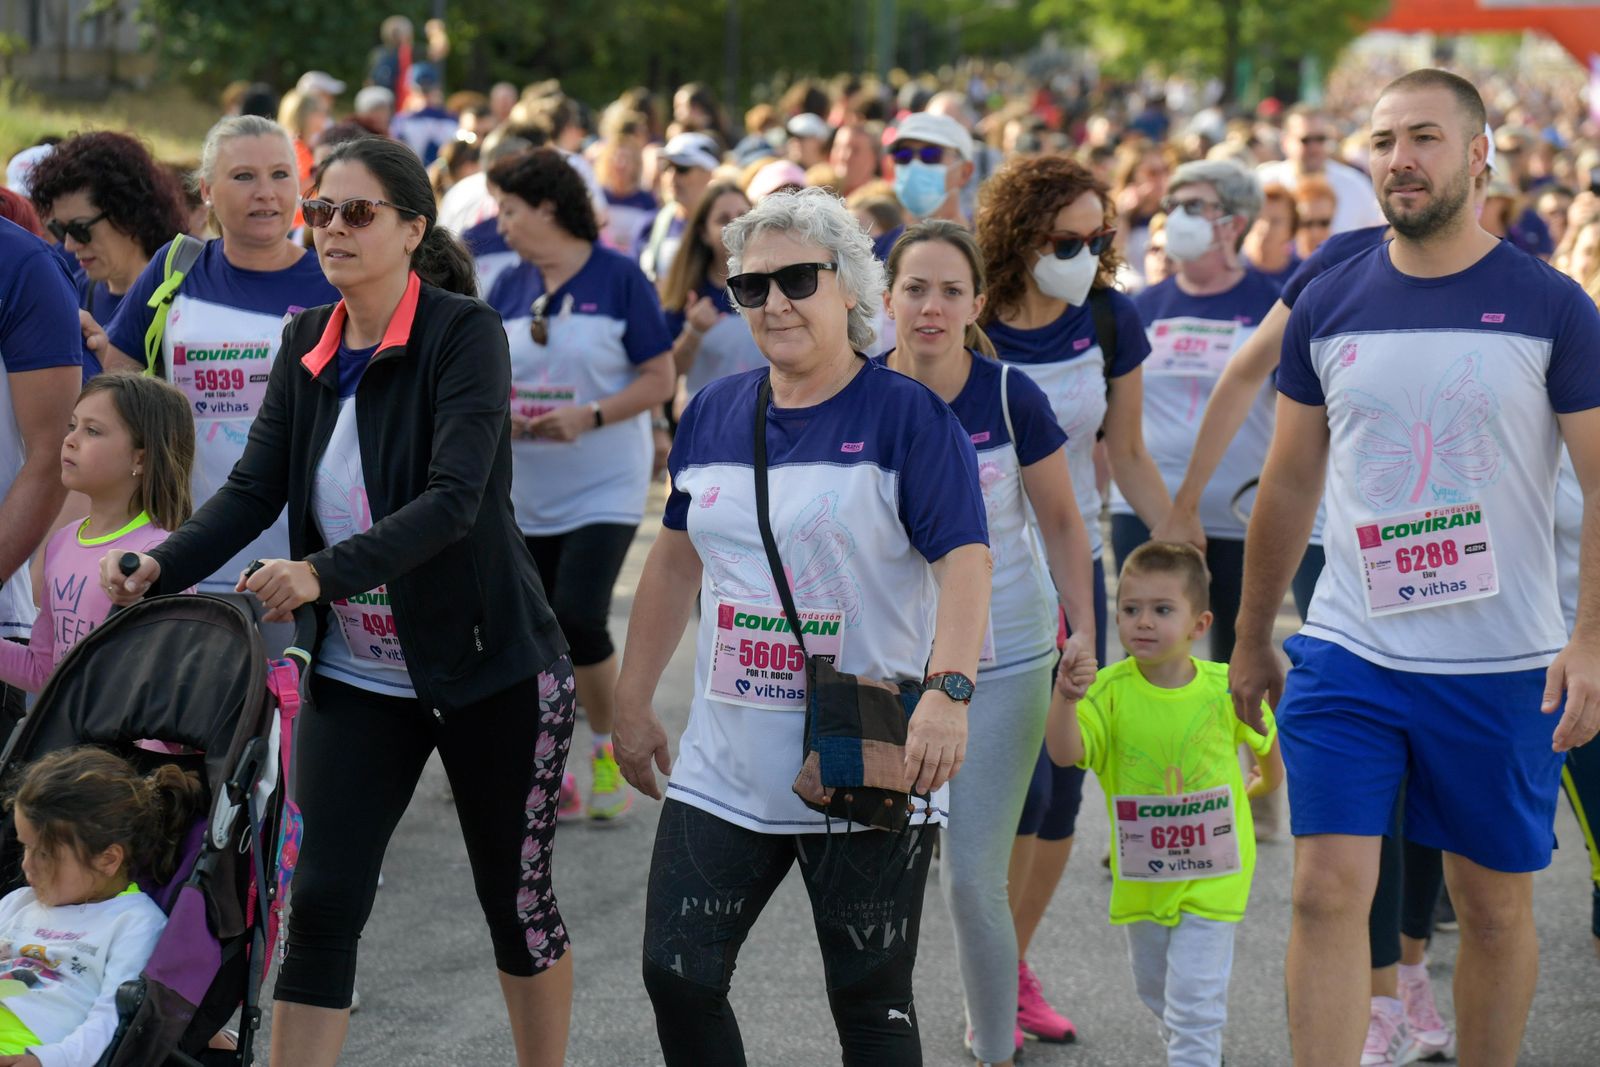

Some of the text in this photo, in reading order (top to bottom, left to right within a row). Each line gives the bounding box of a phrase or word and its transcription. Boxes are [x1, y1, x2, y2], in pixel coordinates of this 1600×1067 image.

[186, 348, 269, 361] COVIRAN
[194, 368, 245, 391] 5939
[210, 401, 249, 413] vithas
[1434, 504, 1480, 517] Fundación
[1381, 511, 1481, 540] COVIRAN
[1395, 539, 1459, 574] 6288
[1420, 580, 1467, 597] vithas
[362, 613, 398, 637] 494
[739, 639, 805, 672] 5605
[746, 668, 759, 678] POR
[771, 671, 793, 681] ROCIO
[754, 685, 805, 699] vithas
[1138, 796, 1229, 817] COVIRAN
[1151, 823, 1206, 849] 6291
[1168, 859, 1213, 871] vithas
